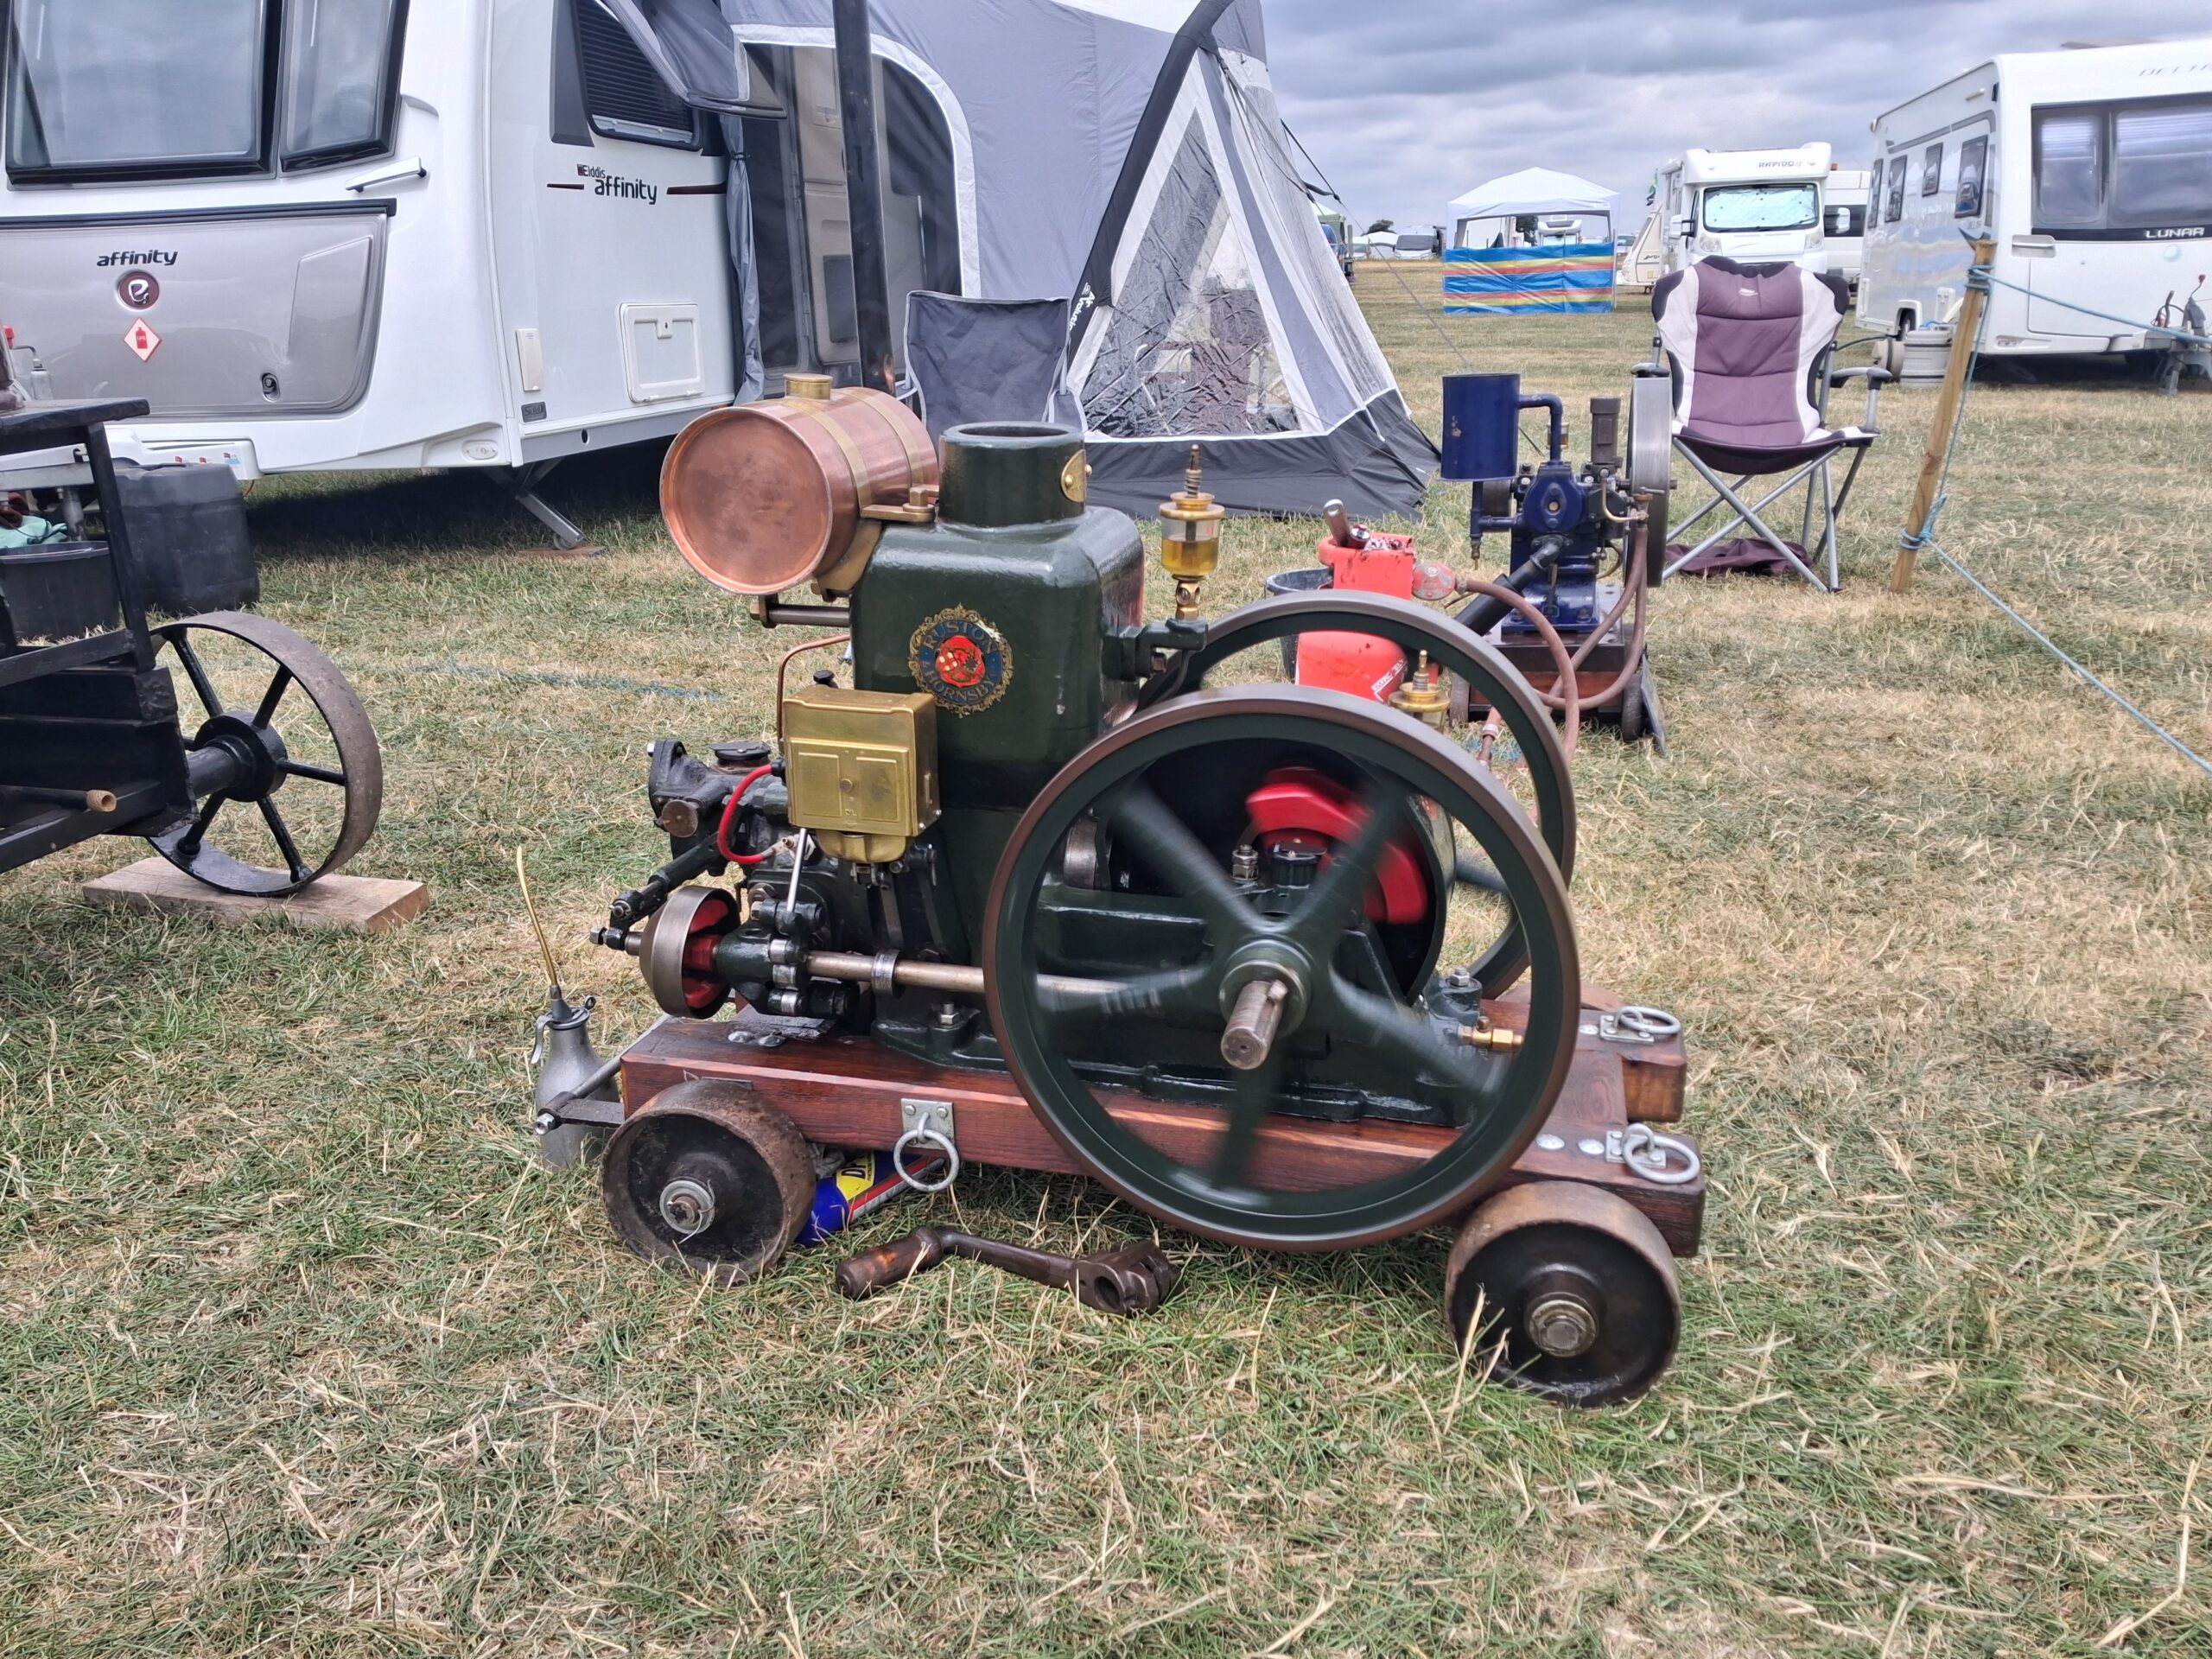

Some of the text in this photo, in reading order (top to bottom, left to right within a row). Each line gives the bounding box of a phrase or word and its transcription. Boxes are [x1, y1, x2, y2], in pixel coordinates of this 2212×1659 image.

[582, 164, 606, 179] Elddis
[594, 175, 657, 205] affinity
[2145, 226, 2205, 238] LUNAR
[97, 249, 178, 267] affinity
[923, 621, 999, 655] RUSTON
[925, 670, 995, 702] HORNSBY
